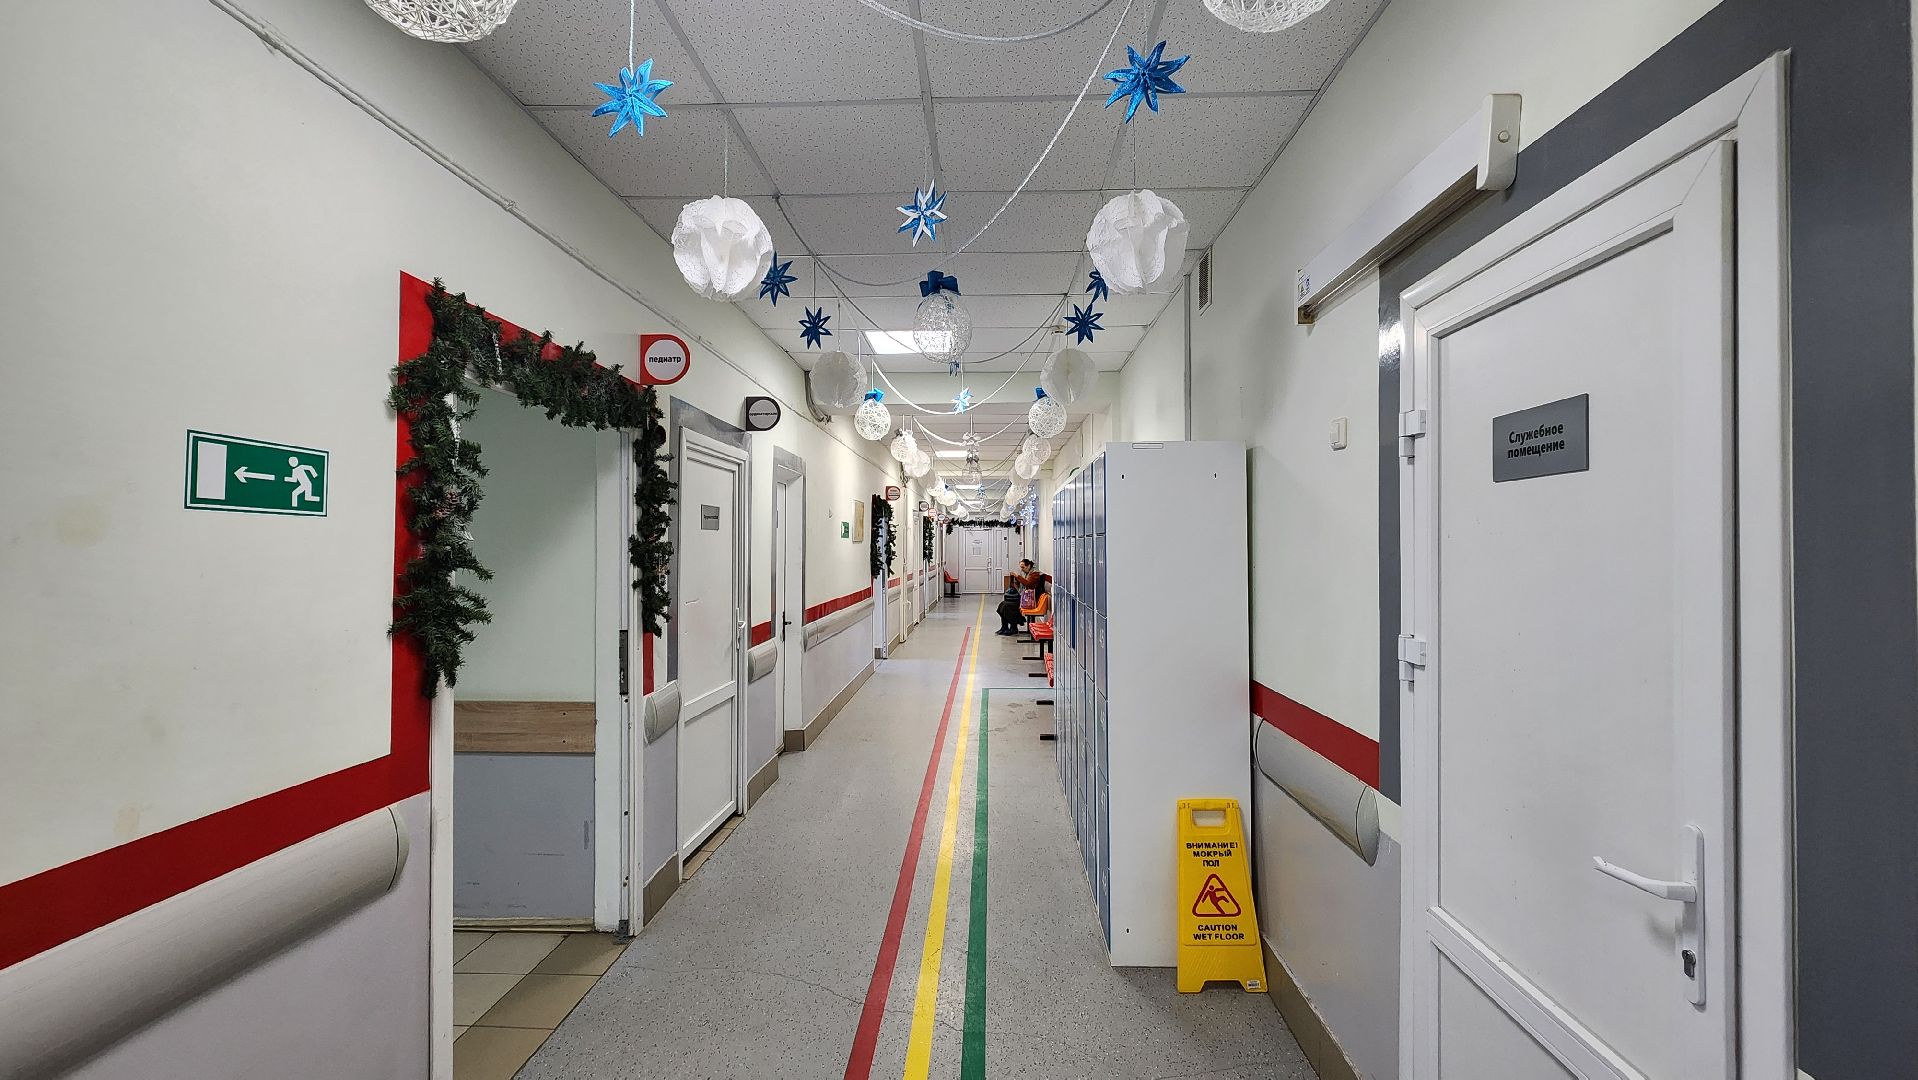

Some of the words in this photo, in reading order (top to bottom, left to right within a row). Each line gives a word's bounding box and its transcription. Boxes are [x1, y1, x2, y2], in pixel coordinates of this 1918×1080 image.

[648, 355, 682, 364] педиатр
[1509, 424, 1564, 446] Служебное
[1507, 439, 1565, 458] помещение
[1193, 849, 1232, 858] МОКРЫЙ
[1202, 859, 1220, 867] ПОЛ
